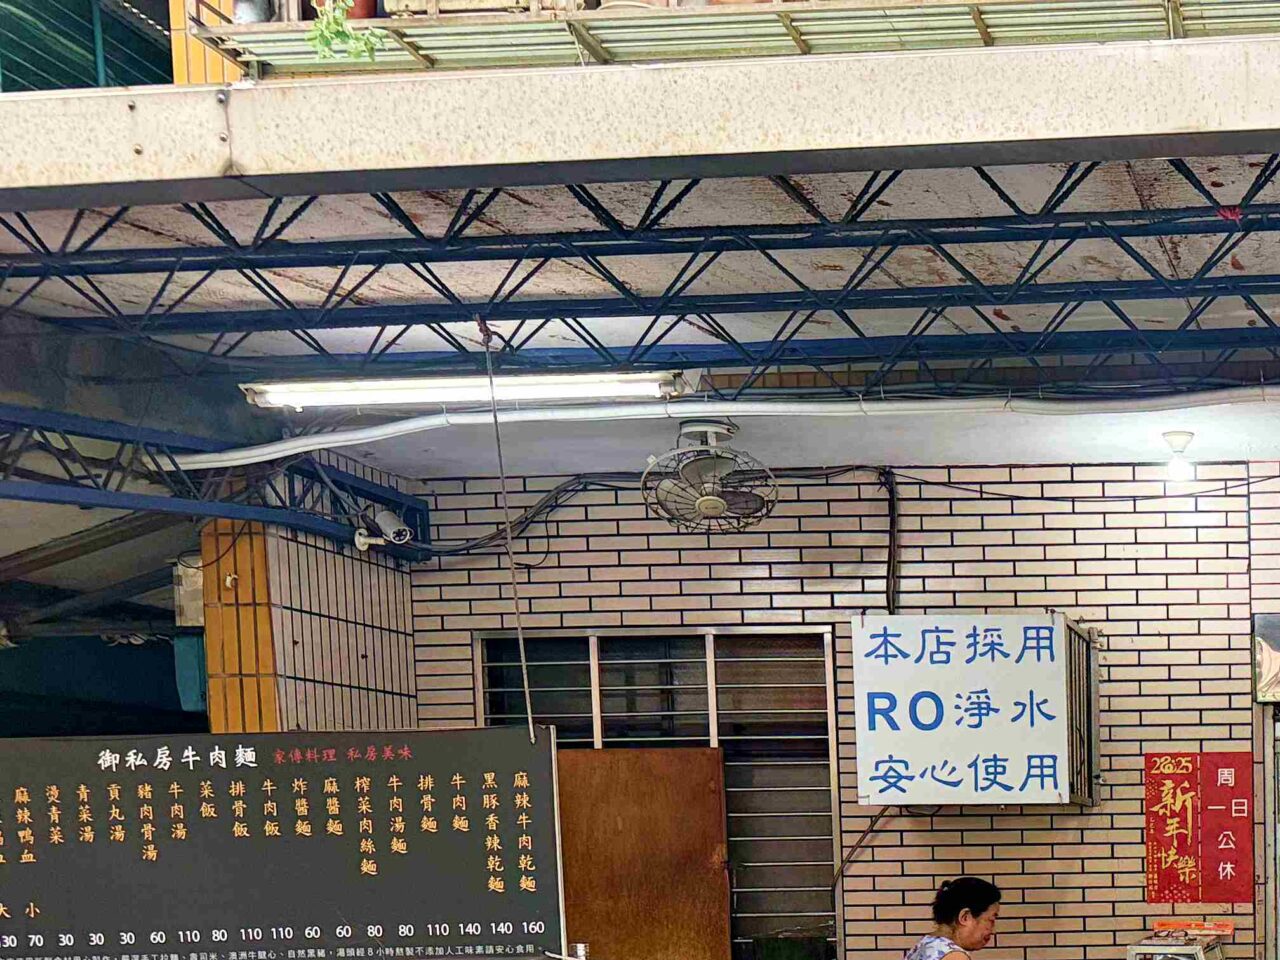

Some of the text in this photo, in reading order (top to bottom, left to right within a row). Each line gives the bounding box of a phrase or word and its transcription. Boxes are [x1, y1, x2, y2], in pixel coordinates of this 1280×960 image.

[864, 625, 1056, 666] 本店採用
[866, 688, 1057, 732] RO淨水
[97, 744, 258, 772] 御私房牛肉麵
[346, 744, 413, 762] 私房美味
[868, 752, 1060, 794] 安心使用
[14, 786, 37, 863] 麻辣鴨血
[45, 785, 65, 844] 燙青菜
[76, 784, 96, 843] 青菜湯
[106, 783, 127, 843] 貢丸湯
[136, 783, 159, 862] 豬肉骨湯
[168, 781, 189, 841] 牛肉湯
[199, 781, 218, 819] 菜飯
[229, 780, 250, 837] 排骨飯
[260, 779, 282, 837] 牛肉飯
[291, 778, 313, 837] 炸醬麵
[323, 777, 344, 836] 麻醬麵
[354, 776, 379, 876] 榨菜肉絲麵
[386, 775, 409, 854] 牛肉湯麵
[417, 774, 439, 833] 排骨麵
[450, 772, 471, 832] 牛肉麵
[512, 771, 538, 892] 麻辣牛肉乾麵
[1149, 779, 1197, 884] 新年快樂
[0, 921, 545, 948] 30 70 30 30 30 60 110 80 110 110 60 60 80 80 110 140 140 160
[25, 902, 41, 918] 小
